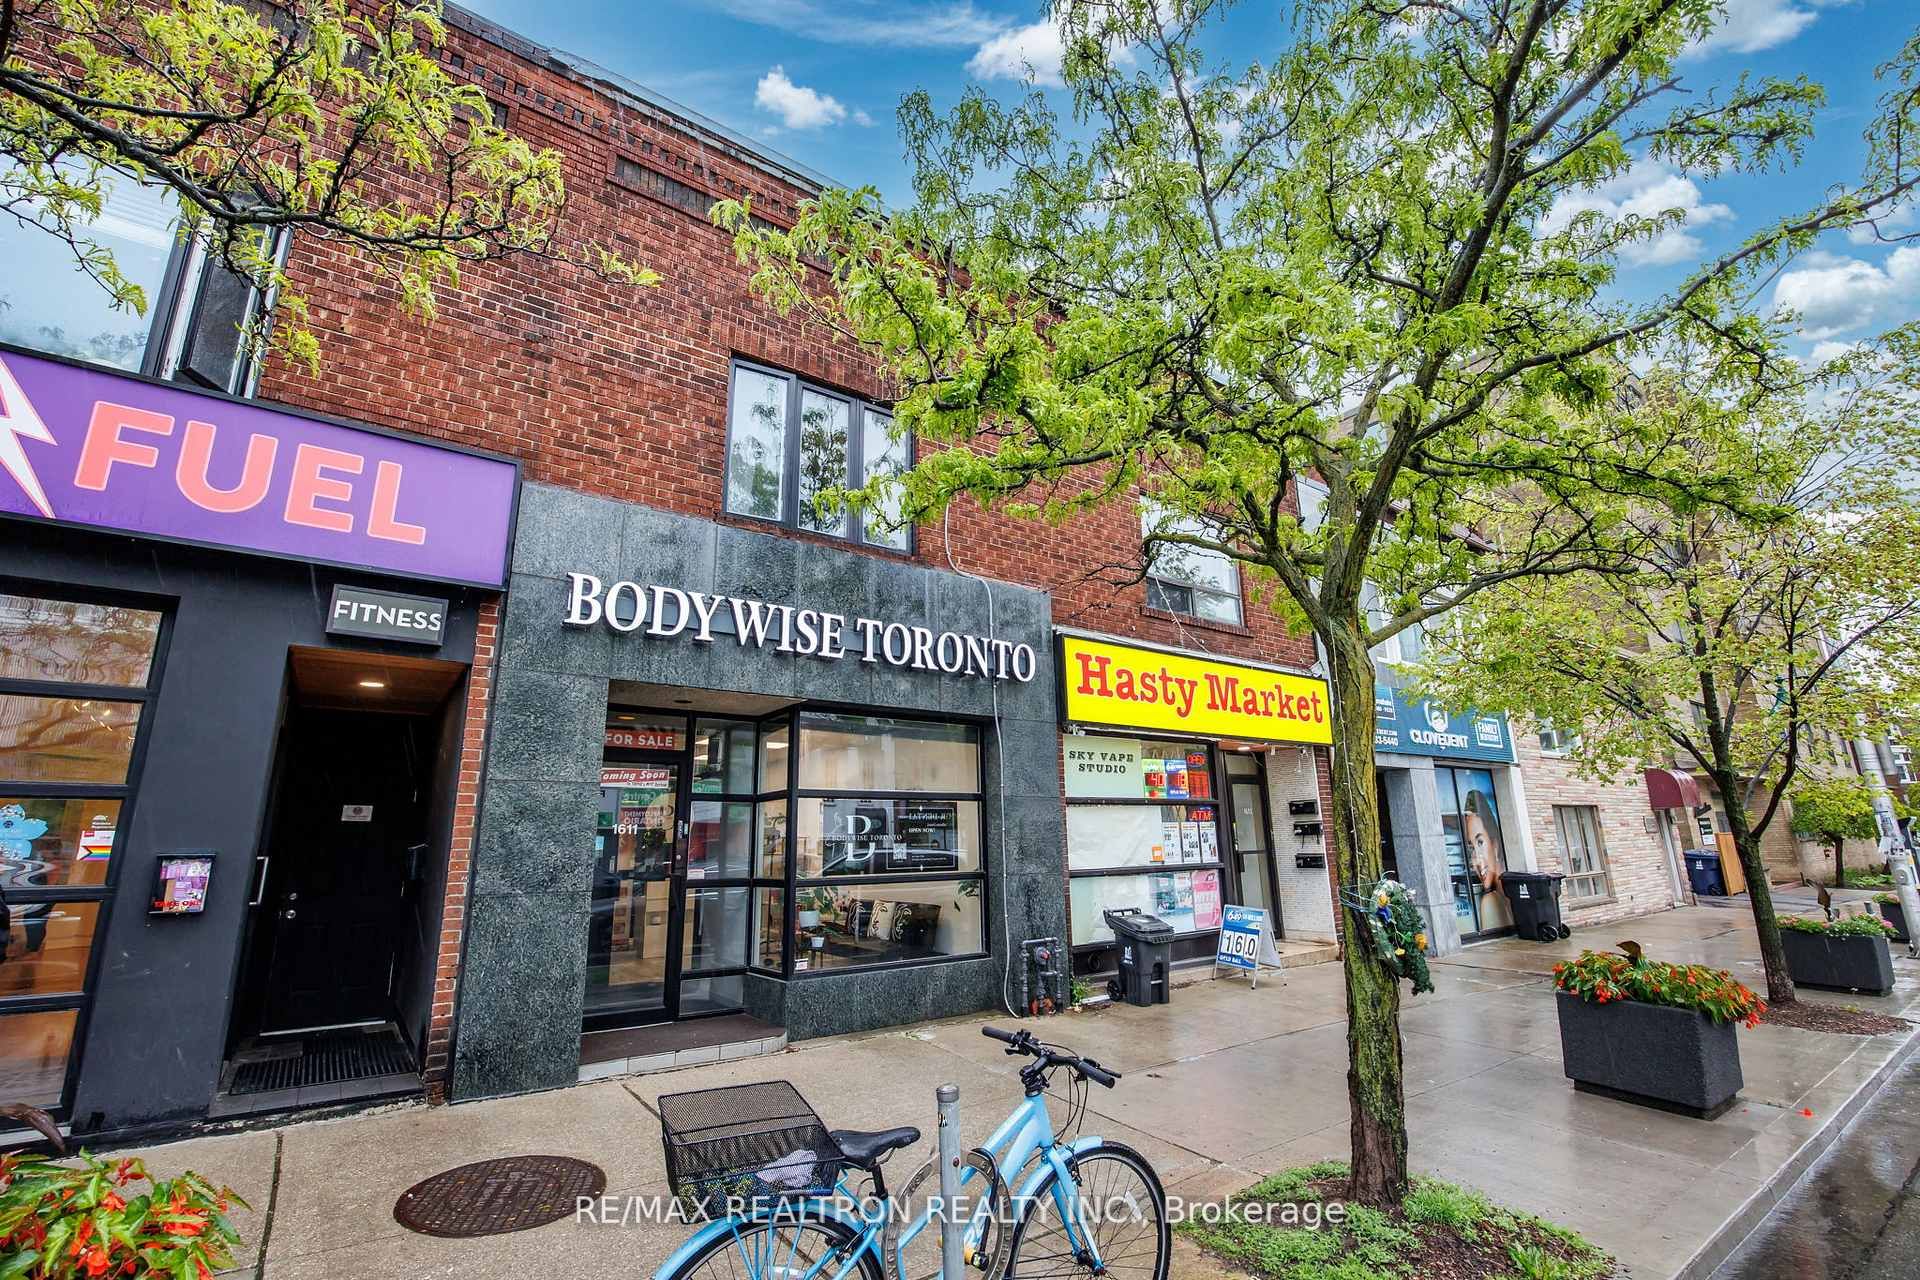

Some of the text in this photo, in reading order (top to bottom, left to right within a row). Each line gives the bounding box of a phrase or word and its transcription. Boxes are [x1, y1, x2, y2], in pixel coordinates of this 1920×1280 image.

[74, 401, 427, 546] FUEL
[333, 599, 442, 632] FITNESS
[857, 617, 1037, 683] TORONTO
[1075, 652, 1323, 724] Hasty Market
[605, 733, 673, 747] FOR SALE
[1409, 728, 1469, 749] CLOVEDENT
[1068, 750, 1135, 763] SKY VAPE
[640, 770, 667, 779] Soon
[1078, 763, 1127, 774] STUDIO
[1191, 811, 1214, 822] ATM
[612, 824, 638, 835] 1611
